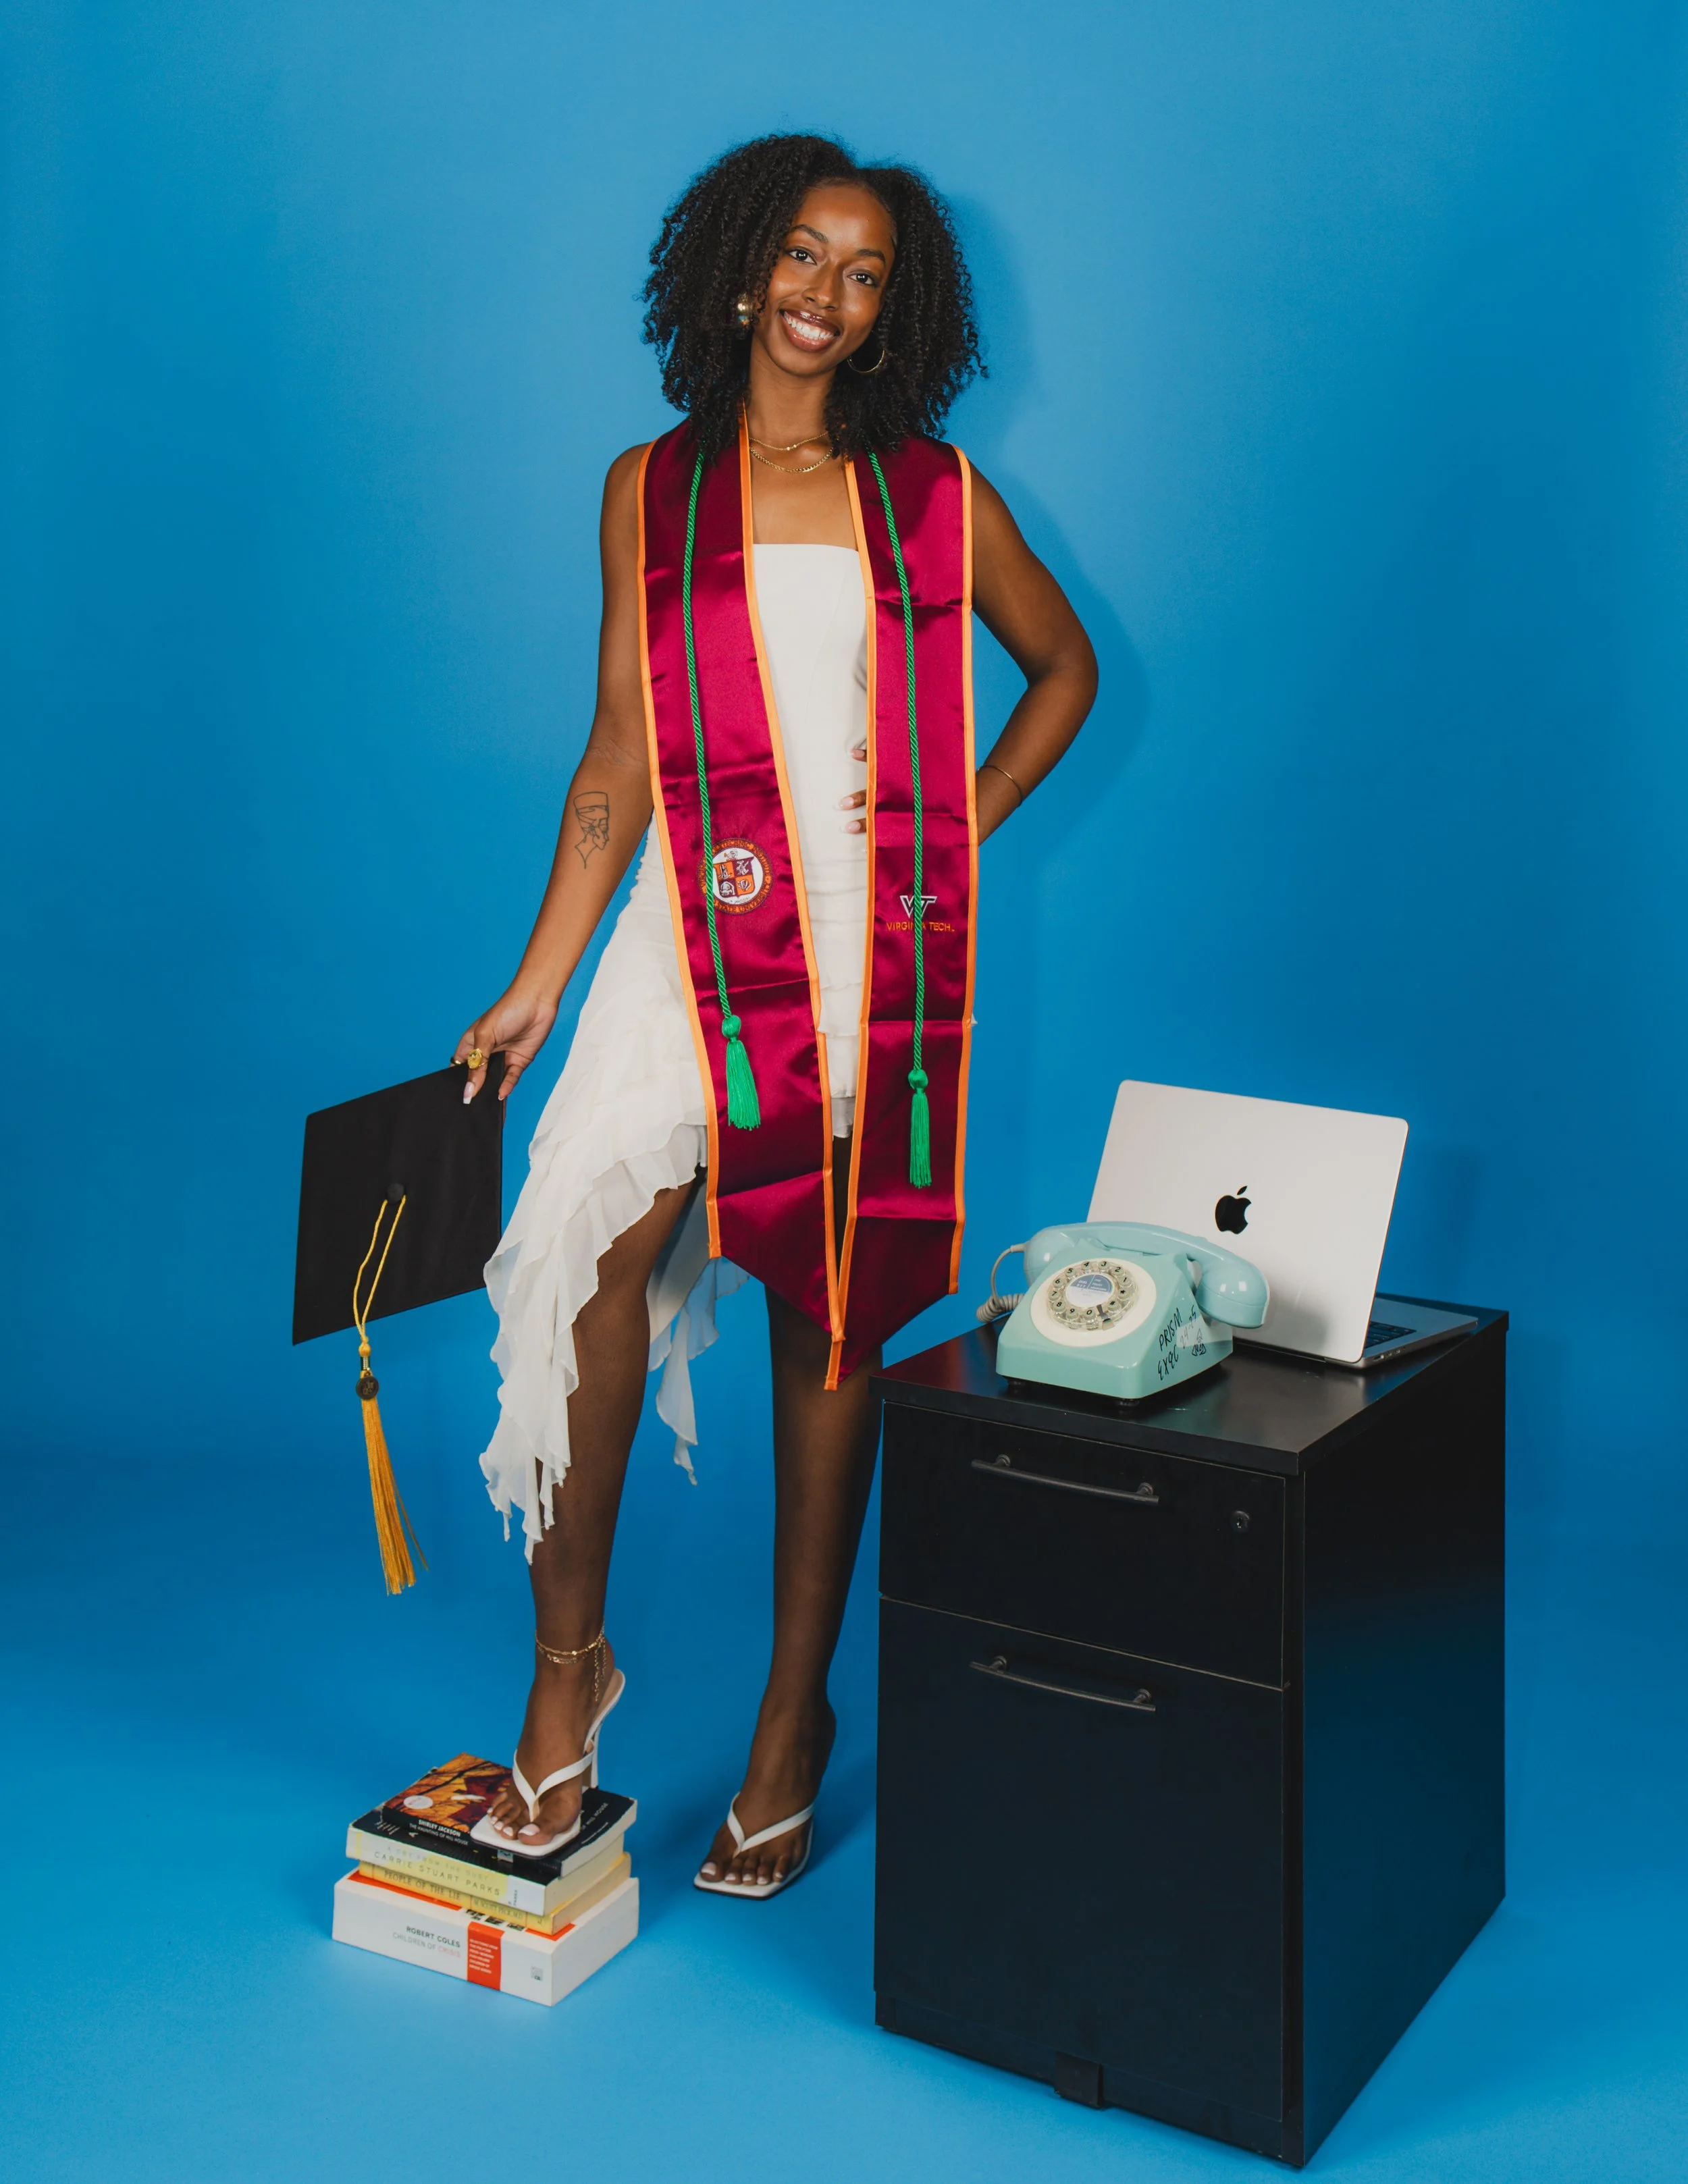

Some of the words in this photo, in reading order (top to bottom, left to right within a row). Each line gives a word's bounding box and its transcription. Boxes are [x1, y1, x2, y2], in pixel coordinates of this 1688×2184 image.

[887, 922, 926, 931] VIRGINA
[1159, 1307, 1182, 1352] PRISM
[419, 1819, 438, 1830] SHIRLEY
[438, 1826, 461, 1837] JACKSON
[374, 1851, 413, 1869] CARRIE
[419, 1865, 459, 1882] STUART
[465, 1879, 500, 1896] PARKS
[384, 1869, 411, 1886] PEOPLE
[415, 1881, 426, 1889] OF
[430, 1884, 444, 1896] THE
[448, 1890, 460, 1900] LIE
[392, 1932, 426, 1948] CHILDREN
[438, 1945, 461, 1958] CRISIS
[406, 1925, 436, 1940] ROBERT
[437, 1936, 461, 1948] COLES
